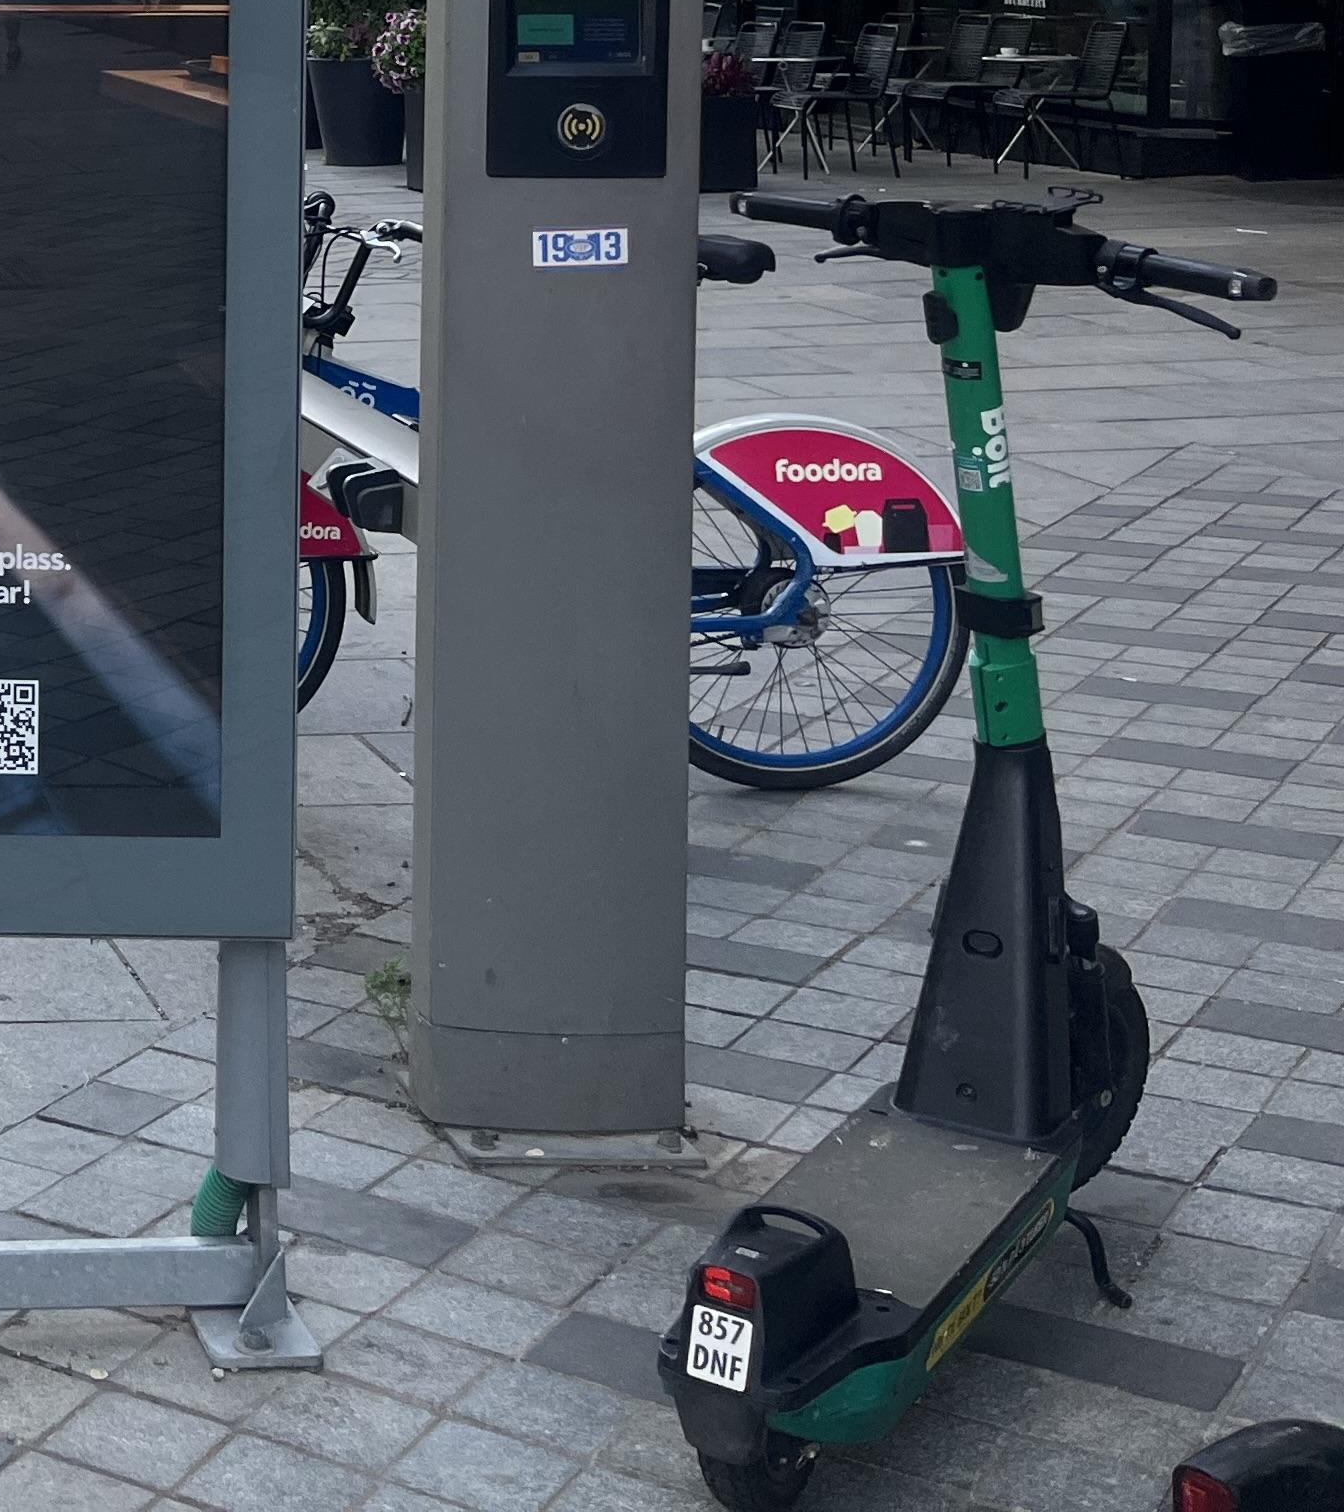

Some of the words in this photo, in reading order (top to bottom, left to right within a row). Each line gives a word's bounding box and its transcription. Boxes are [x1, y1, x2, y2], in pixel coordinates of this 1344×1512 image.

[538, 231, 622, 263] 1913
[980, 404, 1011, 489] Bolt
[775, 458, 883, 483] foodora
[300, 522, 341, 540] dora
[698, 1310, 745, 1345] 857
[692, 1343, 743, 1382] DNF
